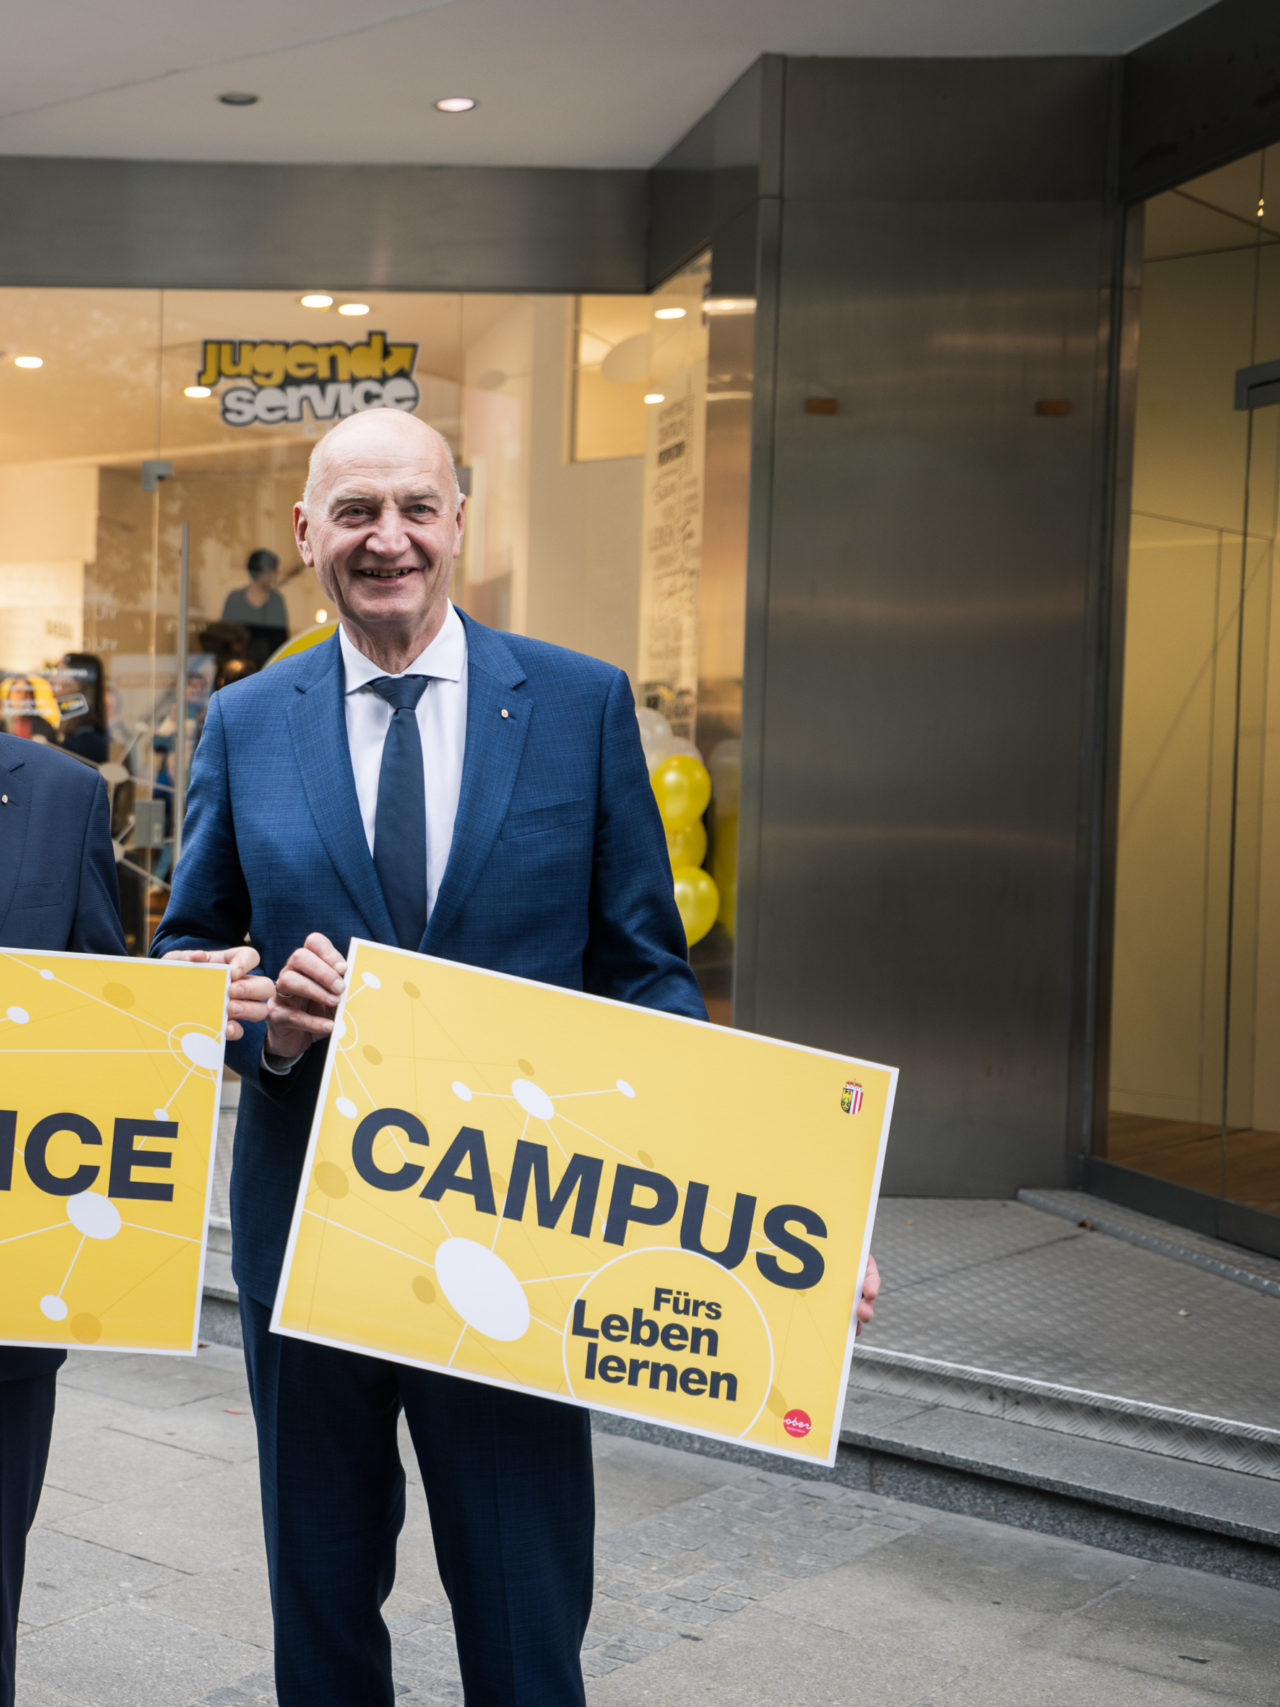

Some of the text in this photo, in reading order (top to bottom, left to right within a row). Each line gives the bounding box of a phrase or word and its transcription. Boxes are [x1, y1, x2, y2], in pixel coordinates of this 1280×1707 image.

[198, 331, 387, 387] jugend
[222, 376, 419, 427] service
[350, 1107, 829, 1291] CAMPUS
[571, 1298, 719, 1357] Leben
[652, 1286, 722, 1321] Fürs
[584, 1341, 739, 1402] lernen
